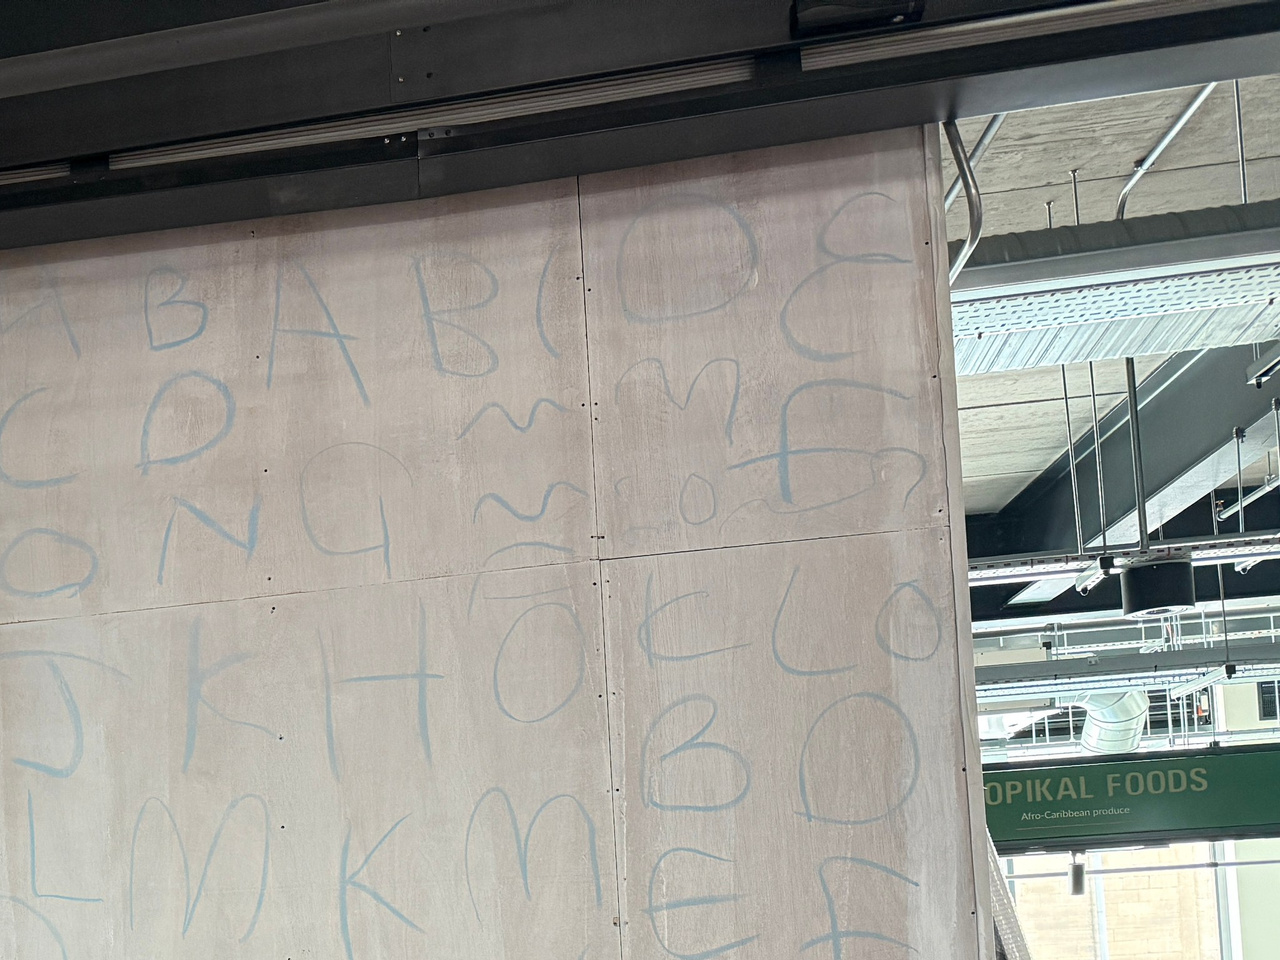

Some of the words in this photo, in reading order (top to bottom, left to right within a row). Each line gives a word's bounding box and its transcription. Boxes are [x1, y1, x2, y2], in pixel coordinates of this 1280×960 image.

[144, 266, 210, 352] B
[266, 258, 372, 407] A
[413, 250, 501, 380] B
[138, 370, 237, 477] D
[179, 617, 286, 773] K
[318, 605, 446, 782] H
[493, 602, 587, 725] O
[640, 694, 754, 813] B
[985, 775, 1094, 806] OPIKAL
[1107, 767, 1209, 797] FOODS
[1021, 807, 1091, 821] Afro-Caribbean
[1092, 805, 1131, 818] produce
[25, 790, 105, 904] L
[464, 785, 603, 926] M
